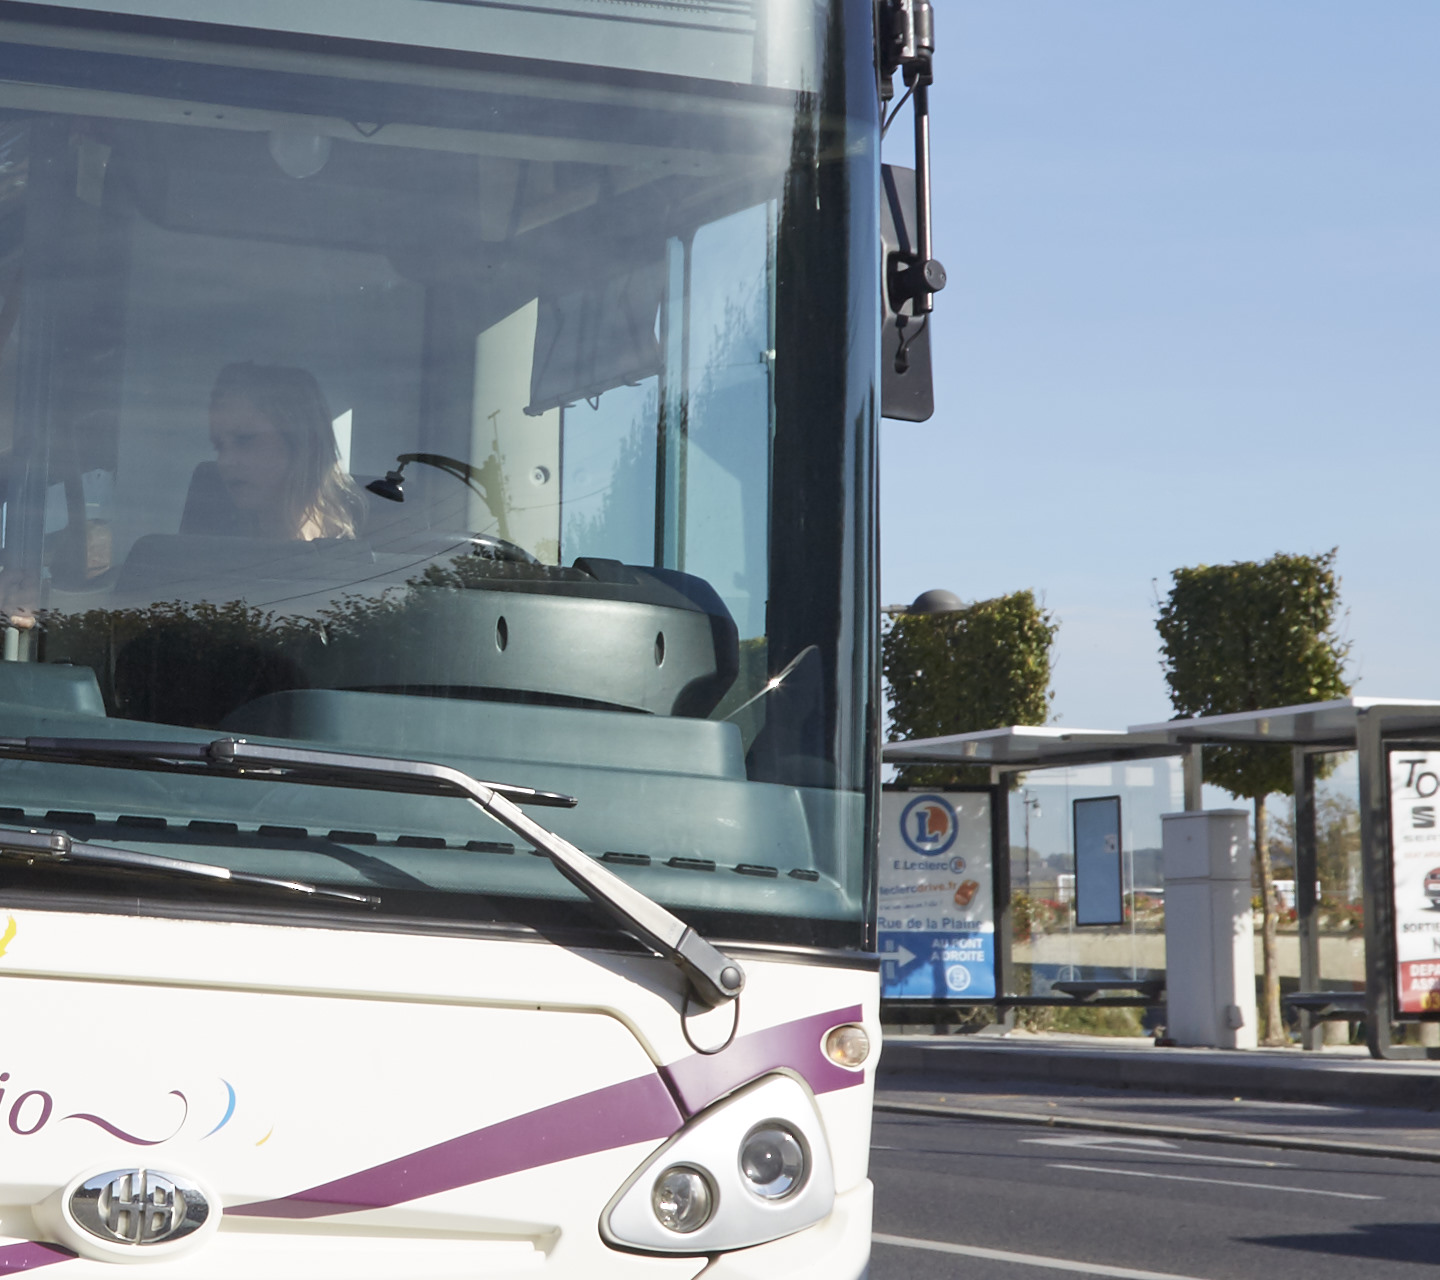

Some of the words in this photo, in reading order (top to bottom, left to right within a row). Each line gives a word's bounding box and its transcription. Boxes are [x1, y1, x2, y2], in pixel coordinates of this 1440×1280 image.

[877, 916, 902, 929] Rue
[907, 916, 922, 929] de
[926, 916, 938, 929] la
[942, 916, 983, 929] Plaine
[1402, 922, 1440, 933] SORTIE
[932, 938, 948, 949] AU
[951, 937, 983, 949] PONT
[943, 950, 985, 962] DROITE
[1421, 991, 1440, 1009] 03
